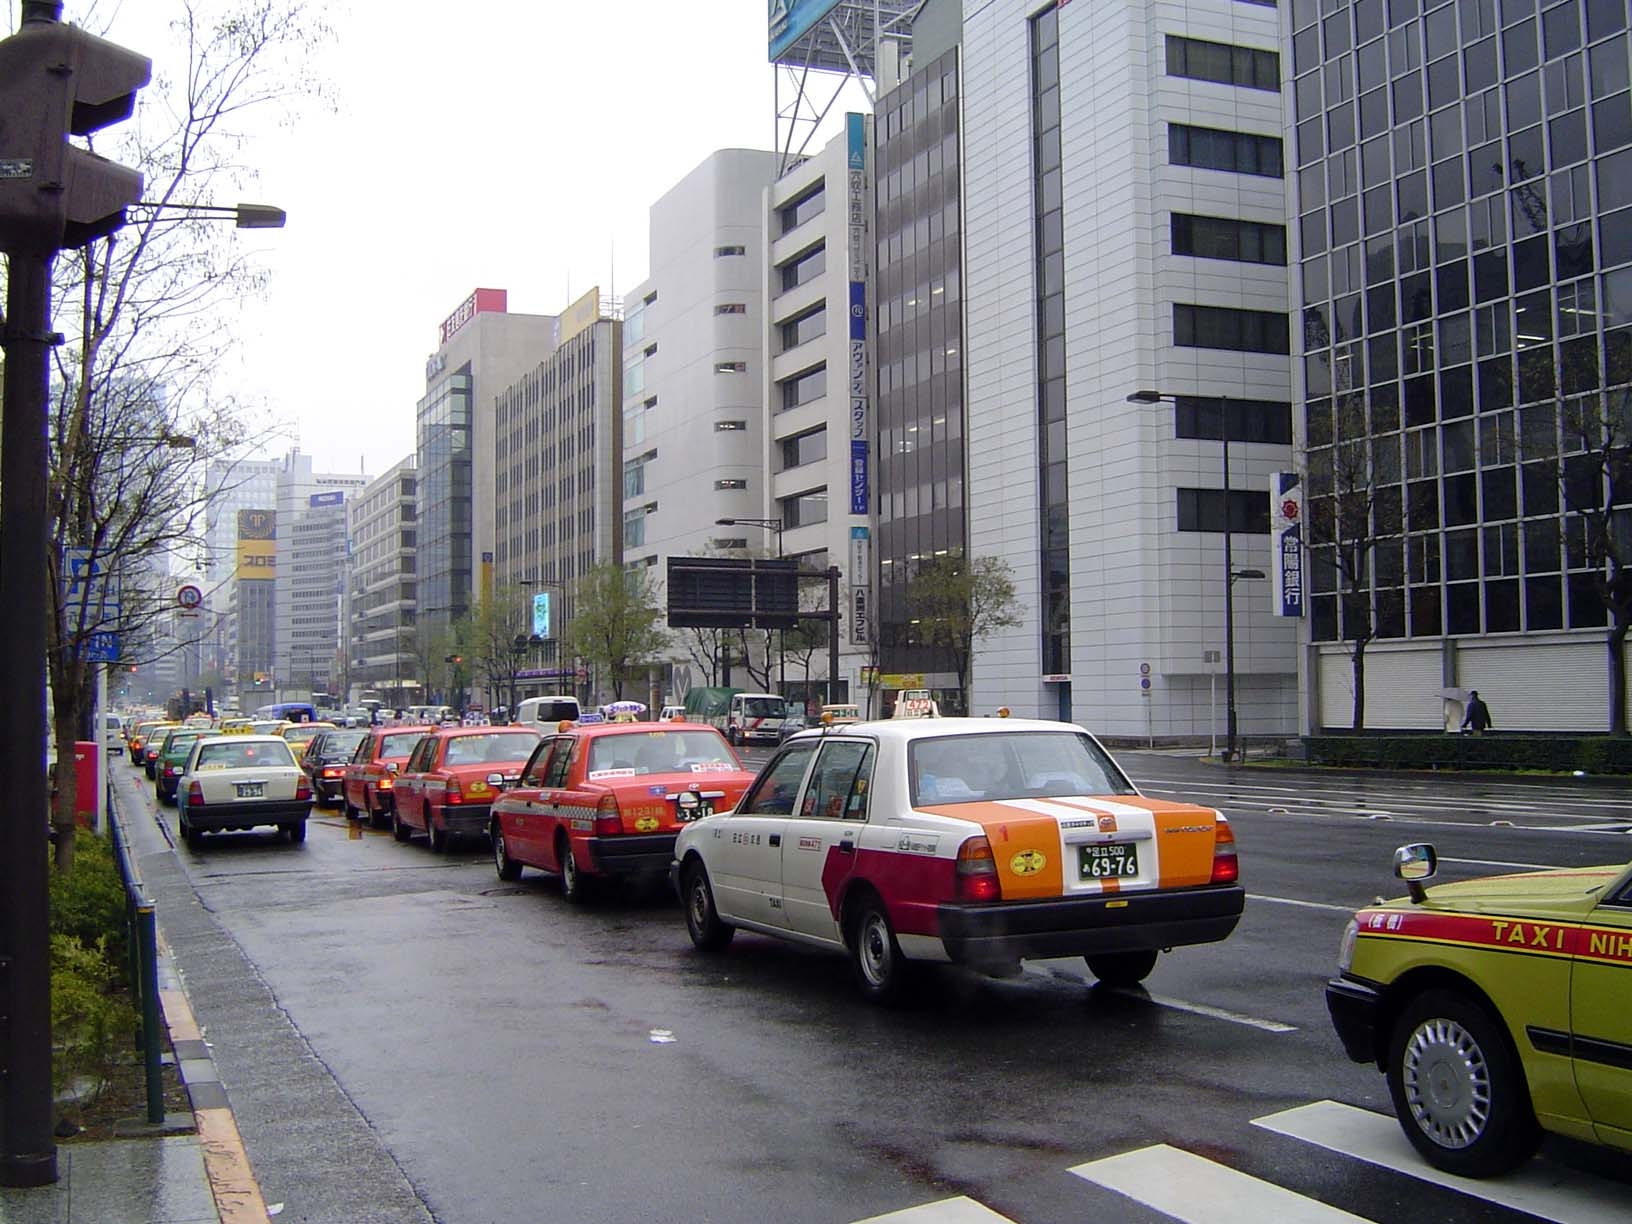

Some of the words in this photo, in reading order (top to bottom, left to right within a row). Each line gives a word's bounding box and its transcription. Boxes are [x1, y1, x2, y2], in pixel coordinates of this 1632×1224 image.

[854, 400, 864, 437] スタッフ
[1283, 535, 1300, 605] 常陽銀行
[1109, 846, 1125, 856] 500
[1092, 857, 1135, 877] 69-76
[1492, 920, 1564, 949] TAXI
